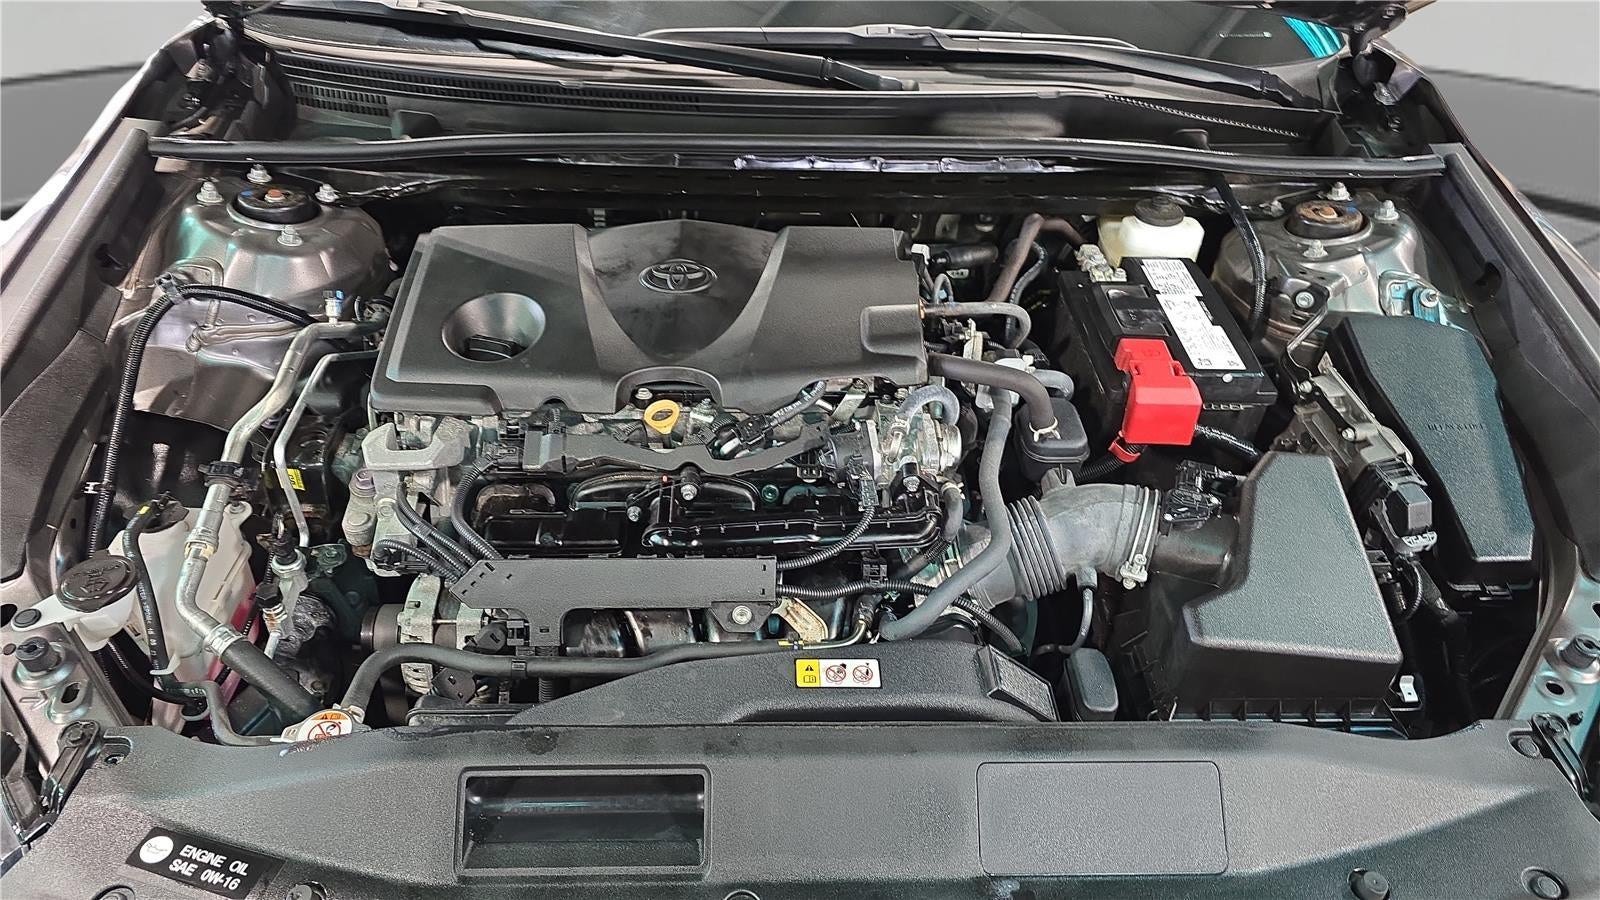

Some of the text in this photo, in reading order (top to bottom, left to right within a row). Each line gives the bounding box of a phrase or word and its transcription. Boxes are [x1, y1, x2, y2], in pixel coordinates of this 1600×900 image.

[168, 858, 241, 891] SAE 0W-16
[179, 844, 250, 876] ENGINE OIL
